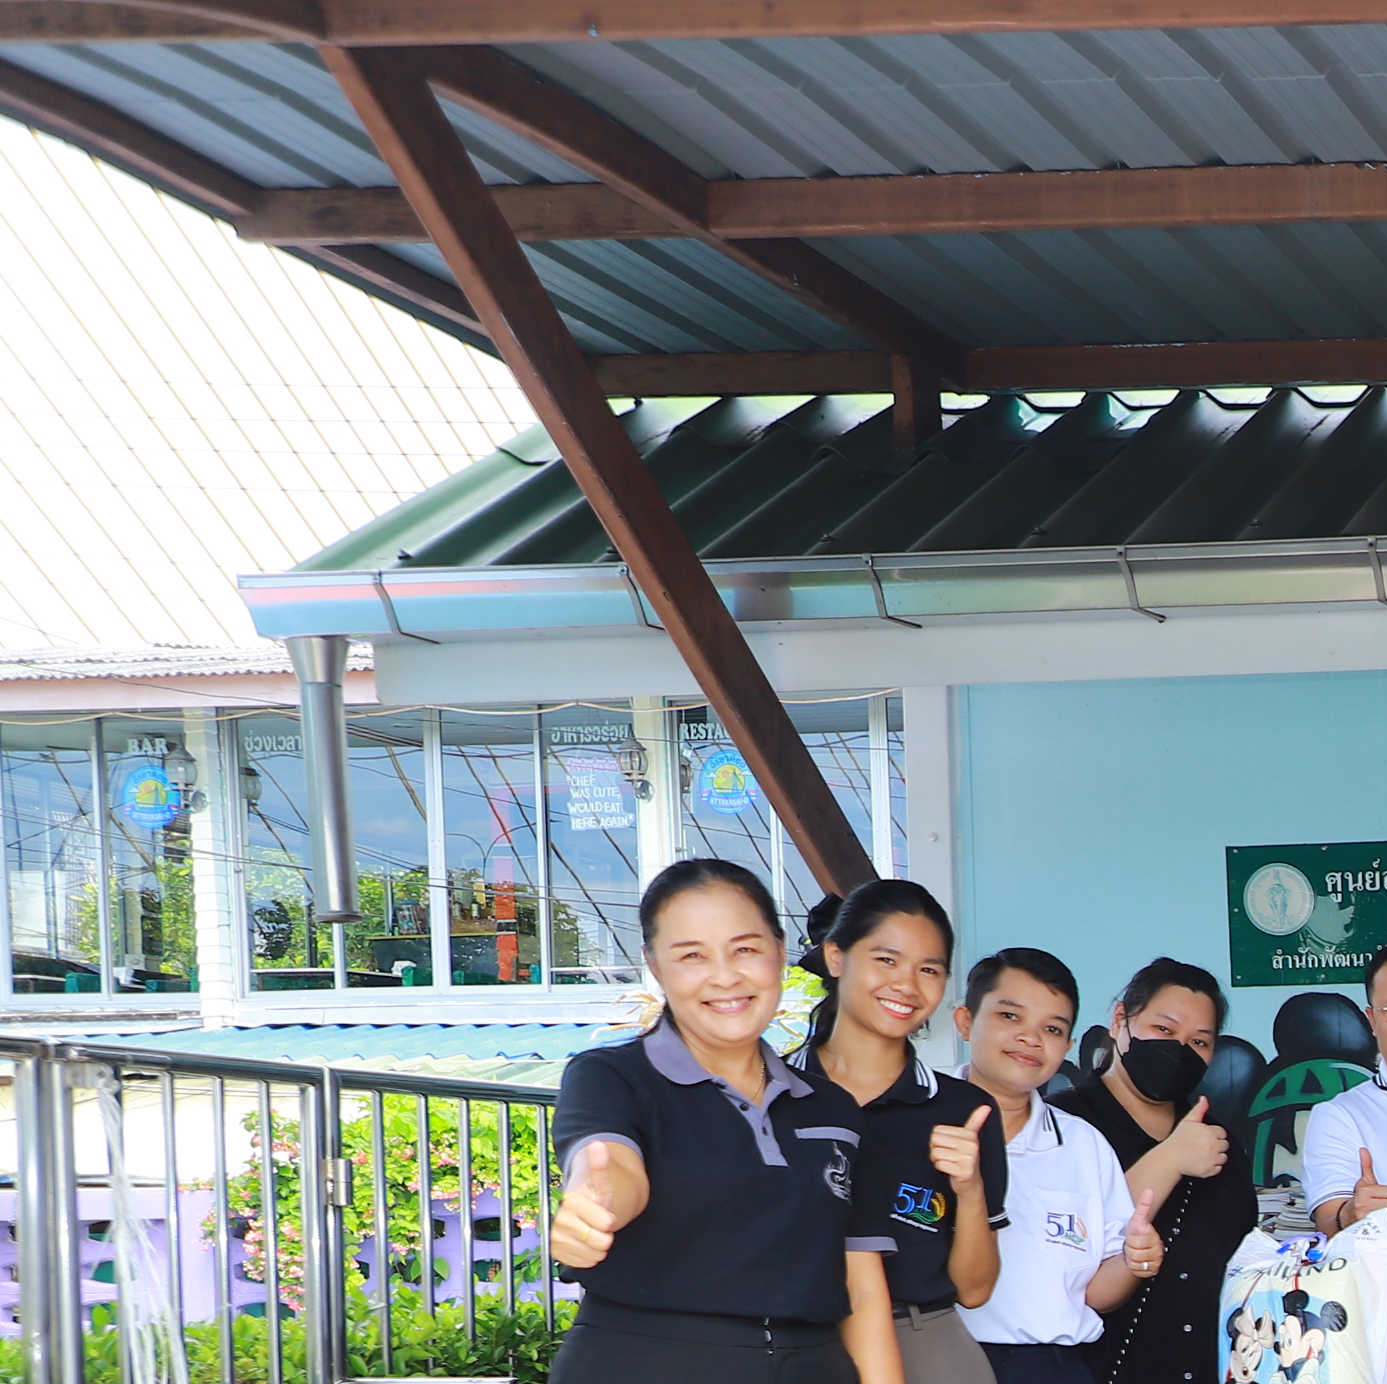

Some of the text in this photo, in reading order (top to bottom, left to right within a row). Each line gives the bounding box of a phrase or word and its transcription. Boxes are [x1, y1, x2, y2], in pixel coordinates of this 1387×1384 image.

[127, 738, 169, 754] BAR
[571, 787, 590, 799] WAS
[568, 802, 621, 815] WOULD EAT
[571, 816, 598, 830] HERE
[893, 1183, 936, 1214] 51
[1045, 1211, 1078, 1238] 51
